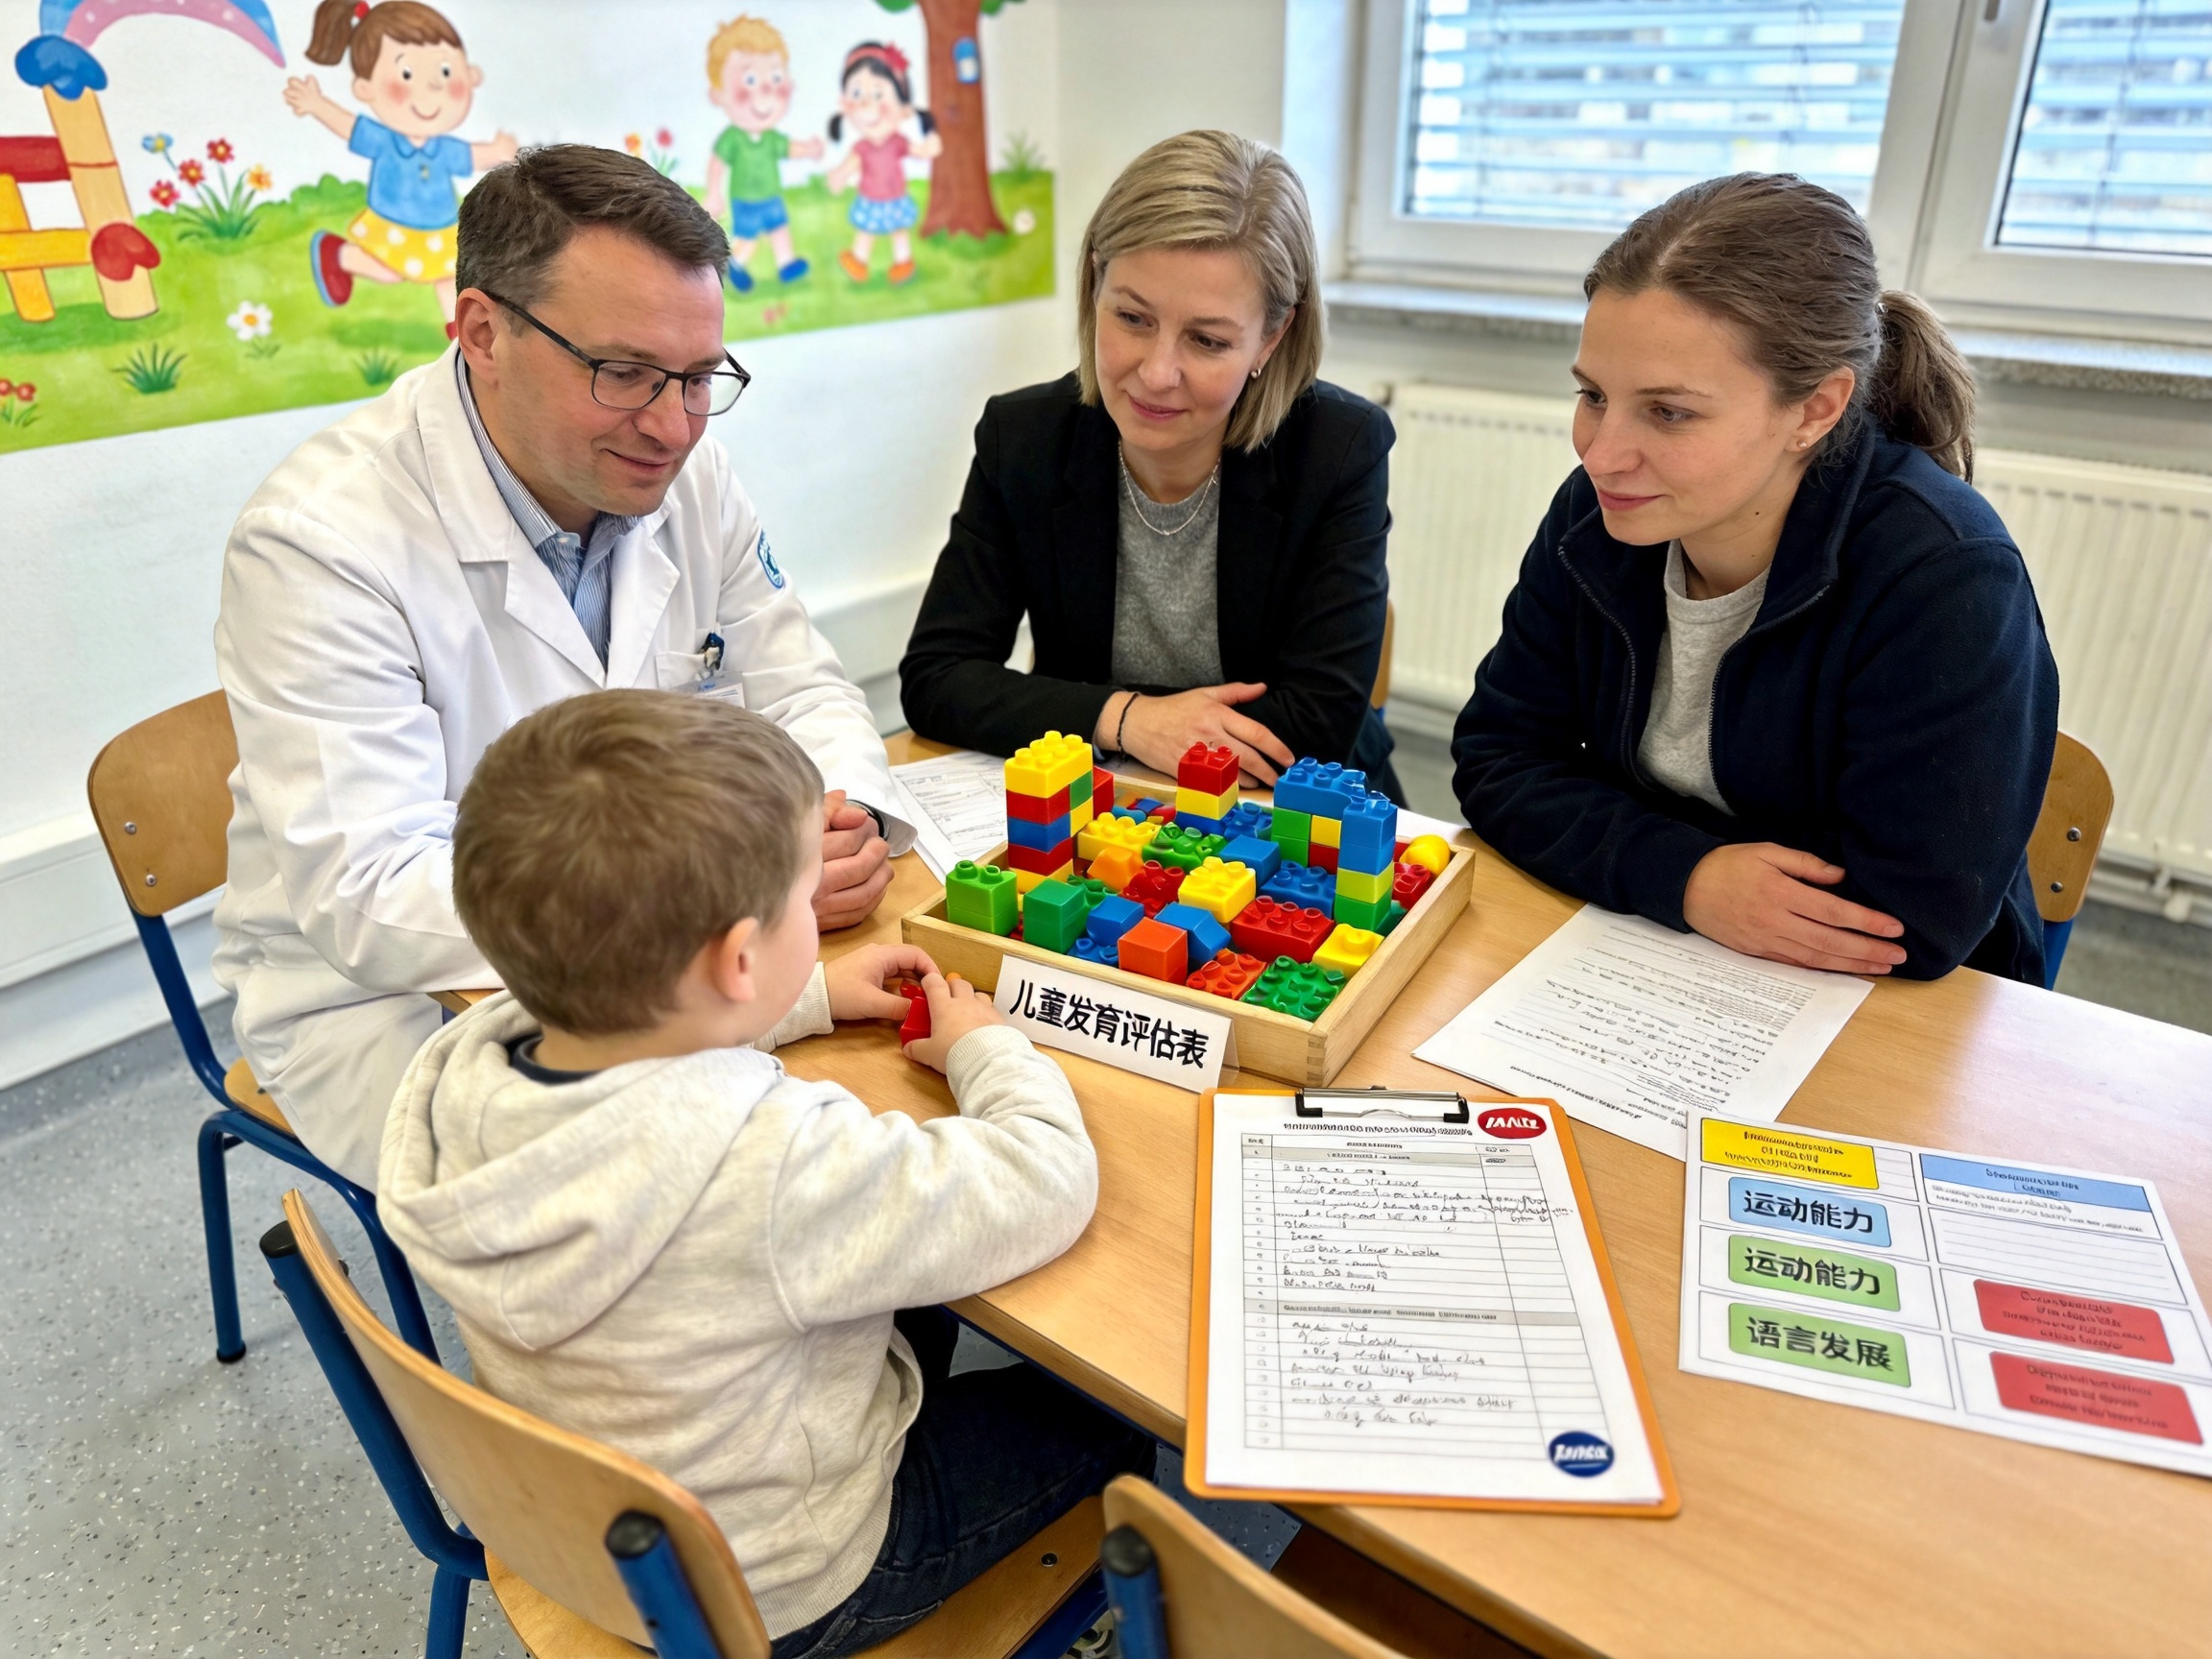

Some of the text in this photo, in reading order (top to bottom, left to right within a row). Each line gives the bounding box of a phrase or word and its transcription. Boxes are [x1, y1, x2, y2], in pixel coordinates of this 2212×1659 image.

[1009, 979, 1210, 1069] 儿童发育评估表
[1743, 1190, 1873, 1233] 运动能力
[1744, 1247, 1881, 1295] 运动能力
[1745, 1316, 1894, 1372] 语言发展
